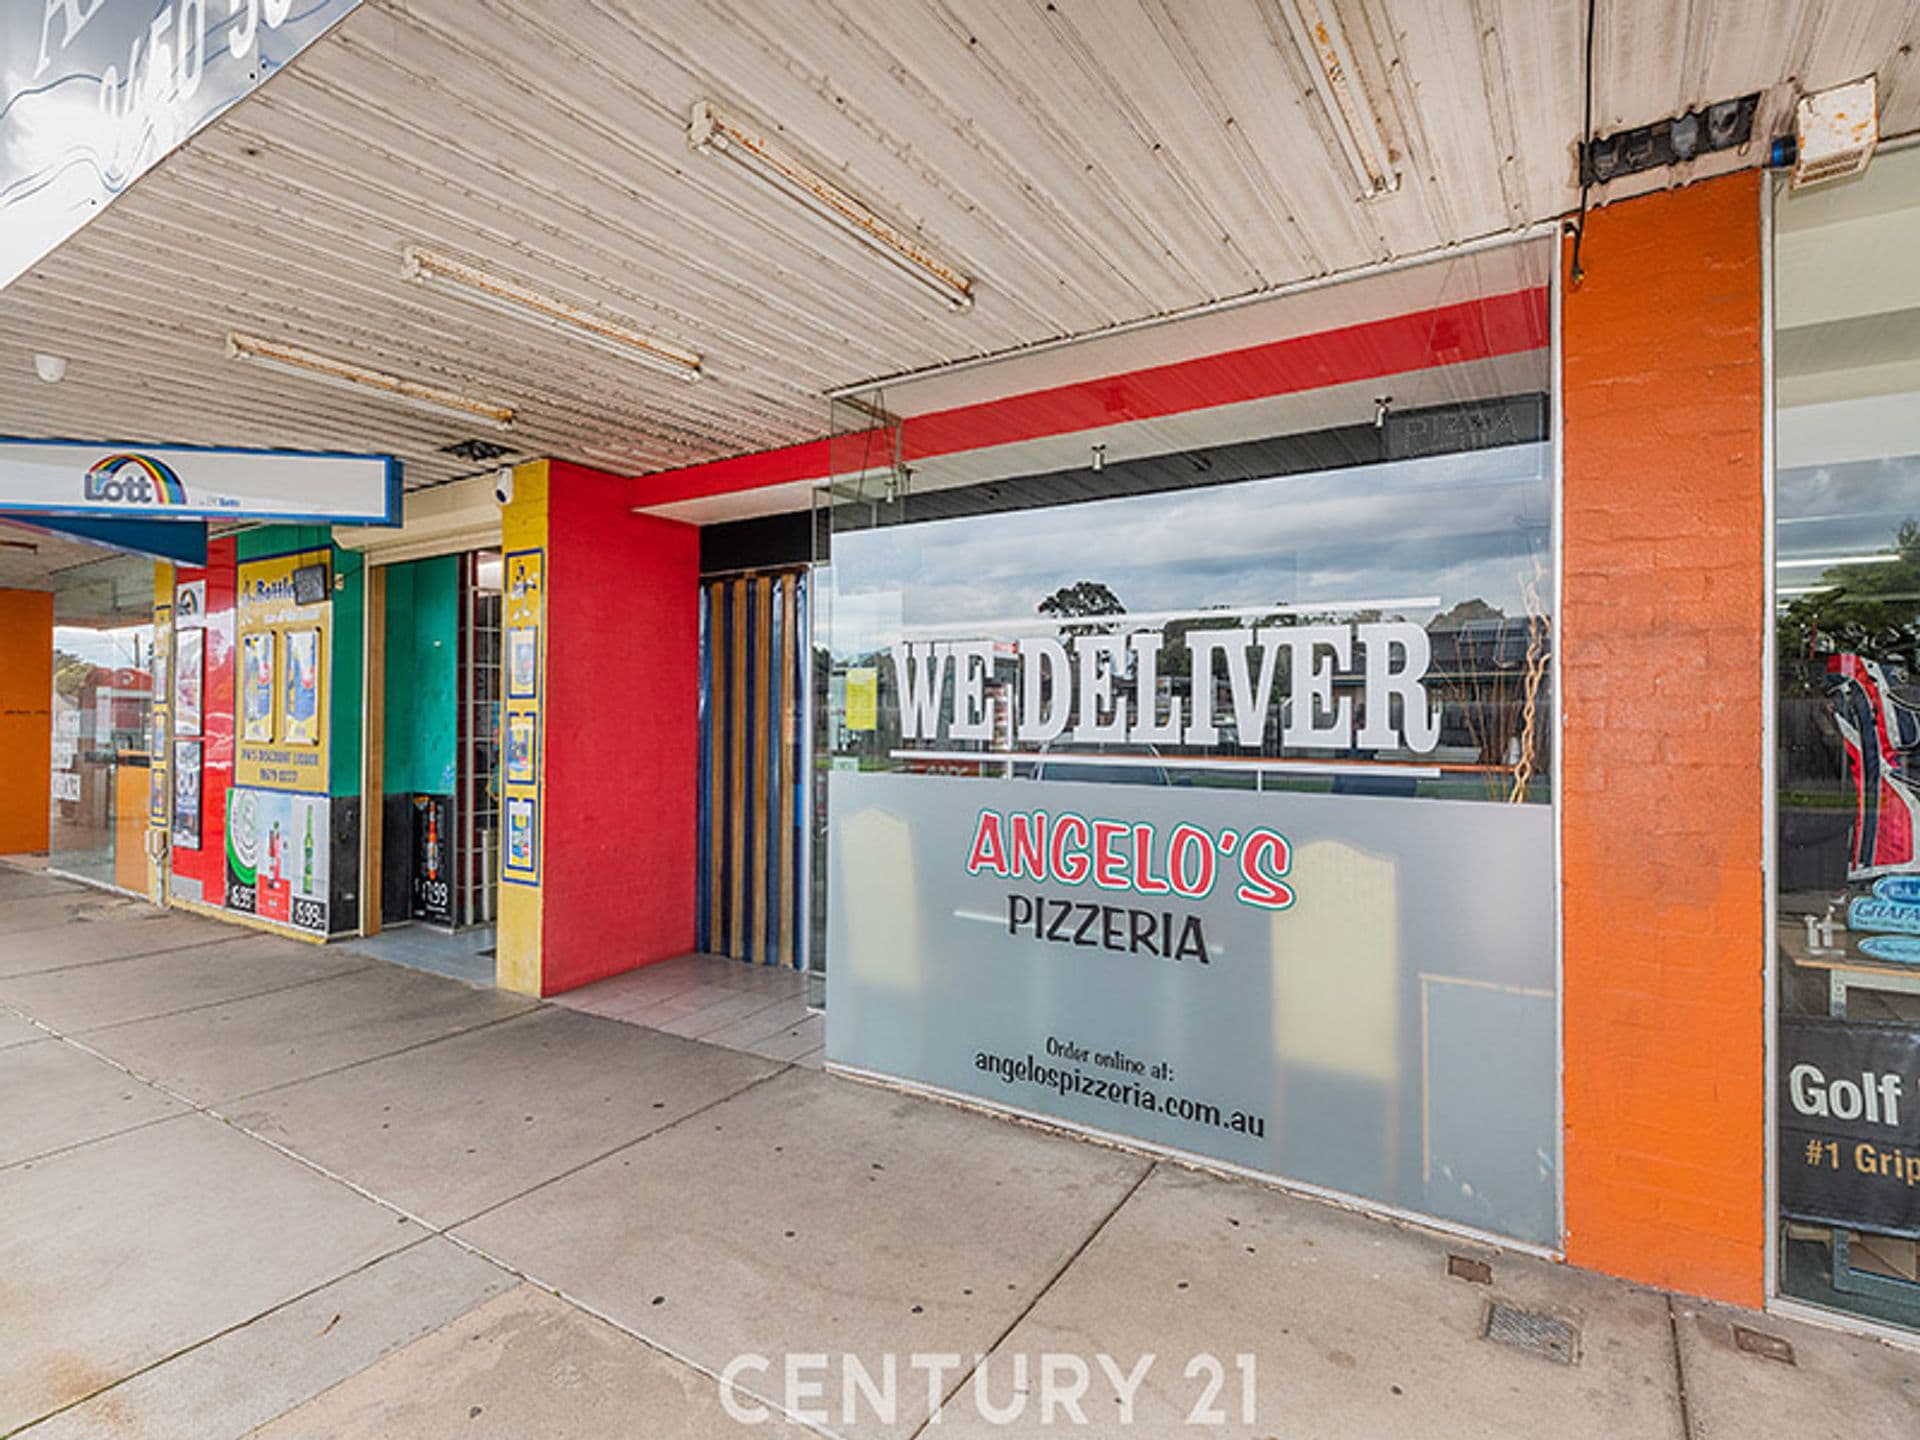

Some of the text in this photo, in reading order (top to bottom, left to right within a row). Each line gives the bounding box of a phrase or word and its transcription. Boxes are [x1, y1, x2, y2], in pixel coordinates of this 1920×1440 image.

[84, 473, 152, 502] Lott
[889, 641, 995, 740] WE
[1014, 624, 1441, 756] DELIVER
[966, 809, 1296, 911] ANGELO'S
[1007, 894, 1211, 965] PIZZERIA
[1046, 1036, 1090, 1064] Order
[1094, 1050, 1146, 1076] online
[974, 1050, 1265, 1138] angelospizzeria.com.au
[1790, 1064, 1902, 1126] Golf
[1805, 1139, 1840, 1170] #1
